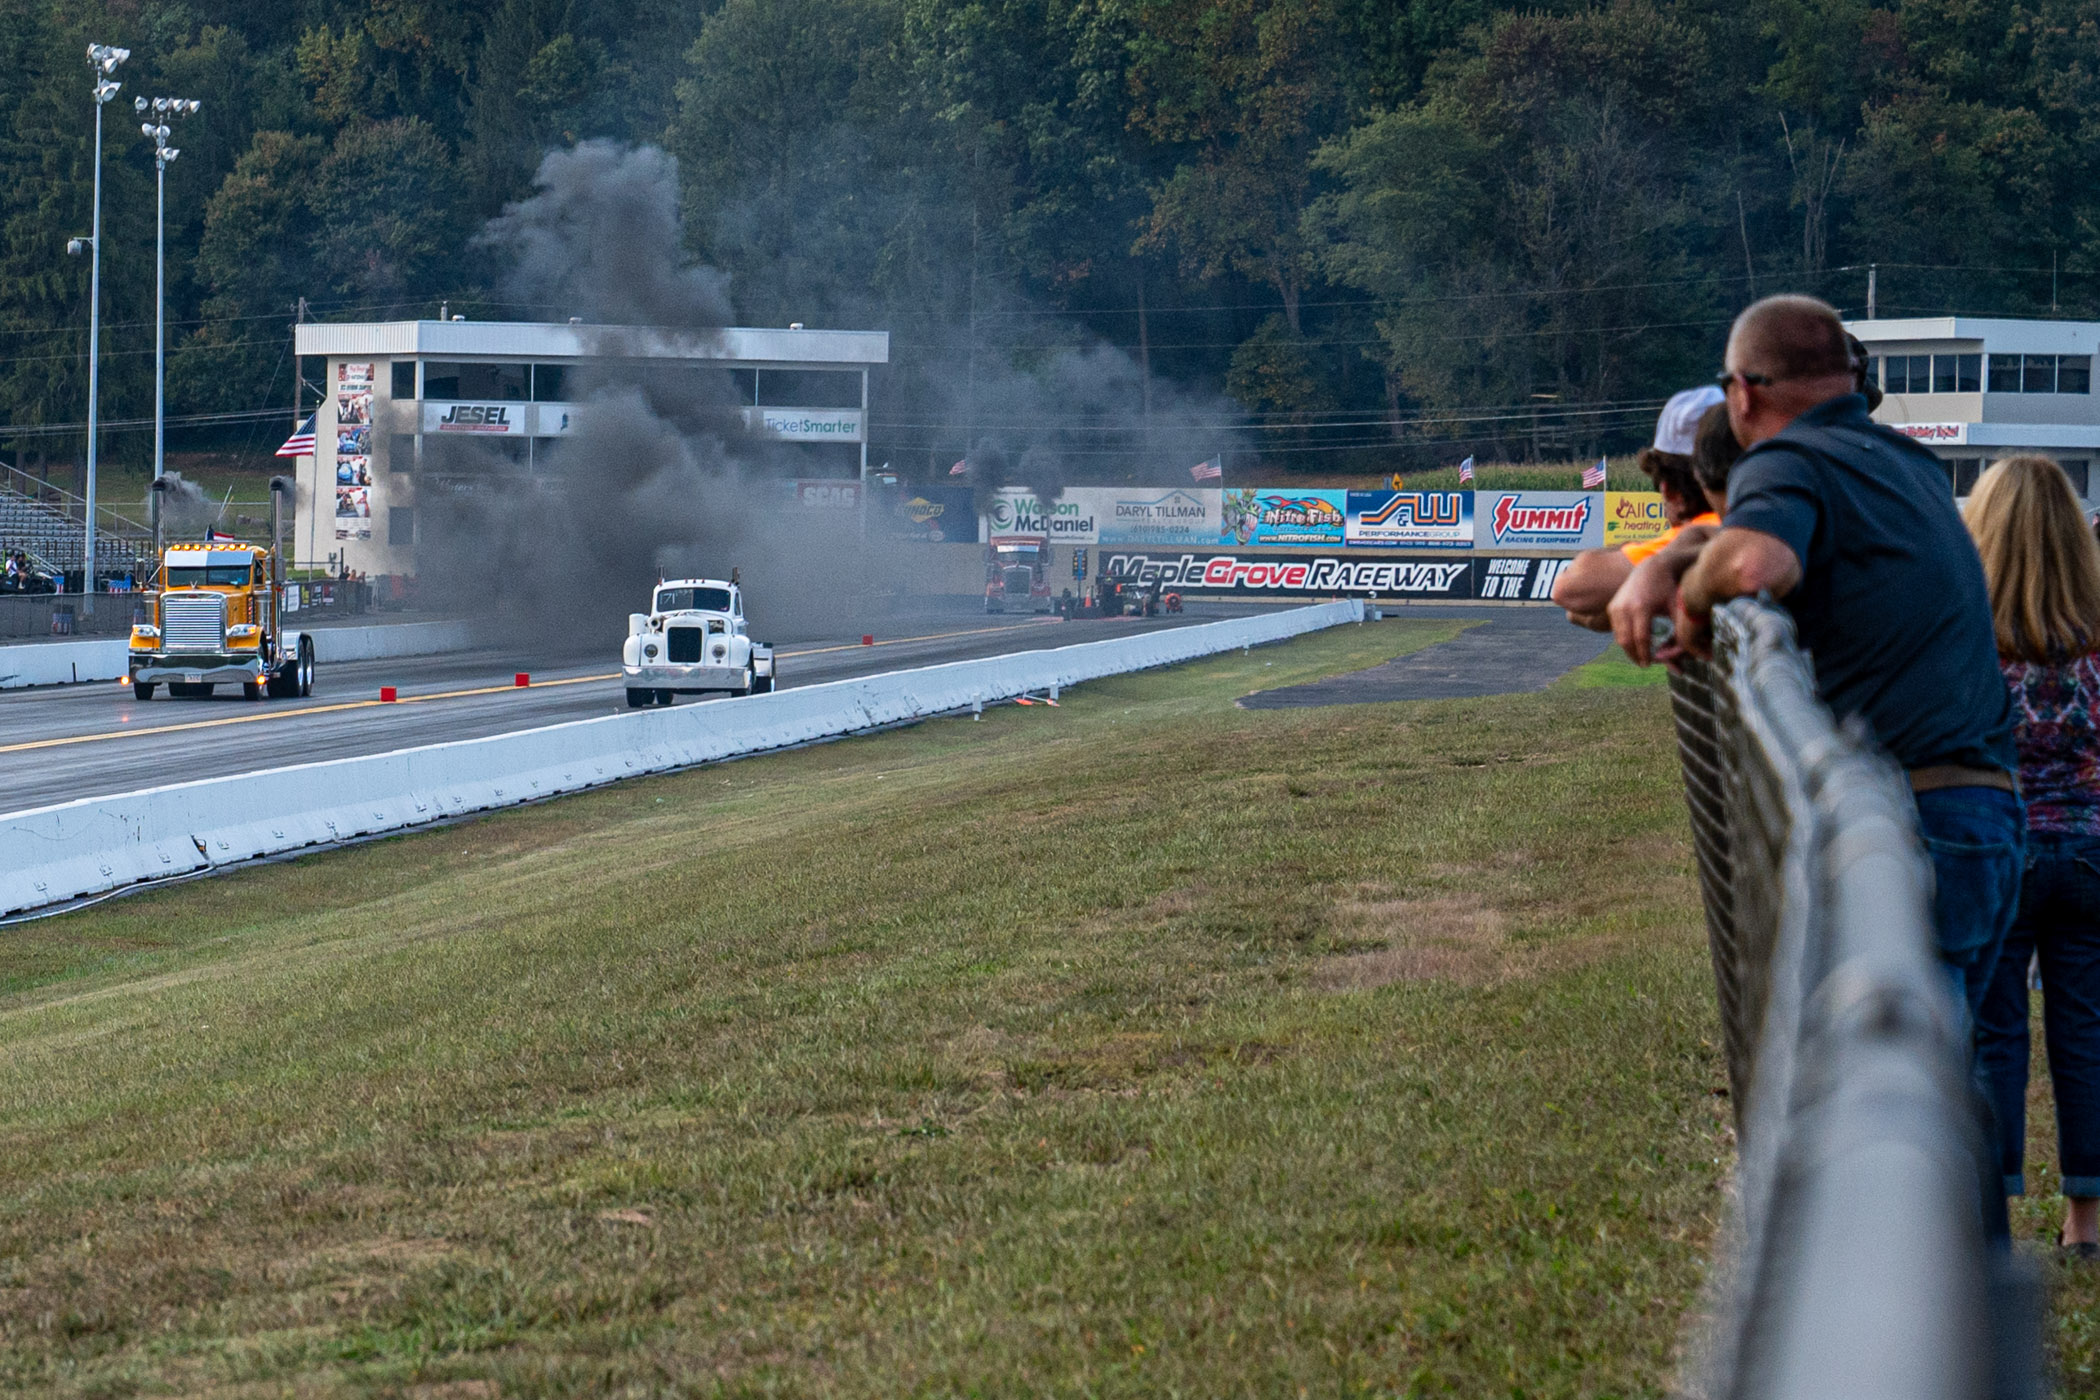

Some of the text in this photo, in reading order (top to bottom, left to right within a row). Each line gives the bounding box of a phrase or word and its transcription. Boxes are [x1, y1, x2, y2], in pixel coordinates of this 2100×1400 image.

[440, 405, 511, 425] JESEL
[766, 418, 857, 434] TicketSmarter
[898, 503, 943, 516] UNOCO
[1015, 499, 1079, 516] Wason
[1116, 506, 1206, 518] DARYL TILLMAN
[1626, 502, 1668, 519] AllCl
[1015, 515, 1094, 532] McDaniel
[1624, 521, 1661, 533] heating
[1488, 559, 1530, 574] WELCOME
[1481, 576, 1525, 598] TO THE
